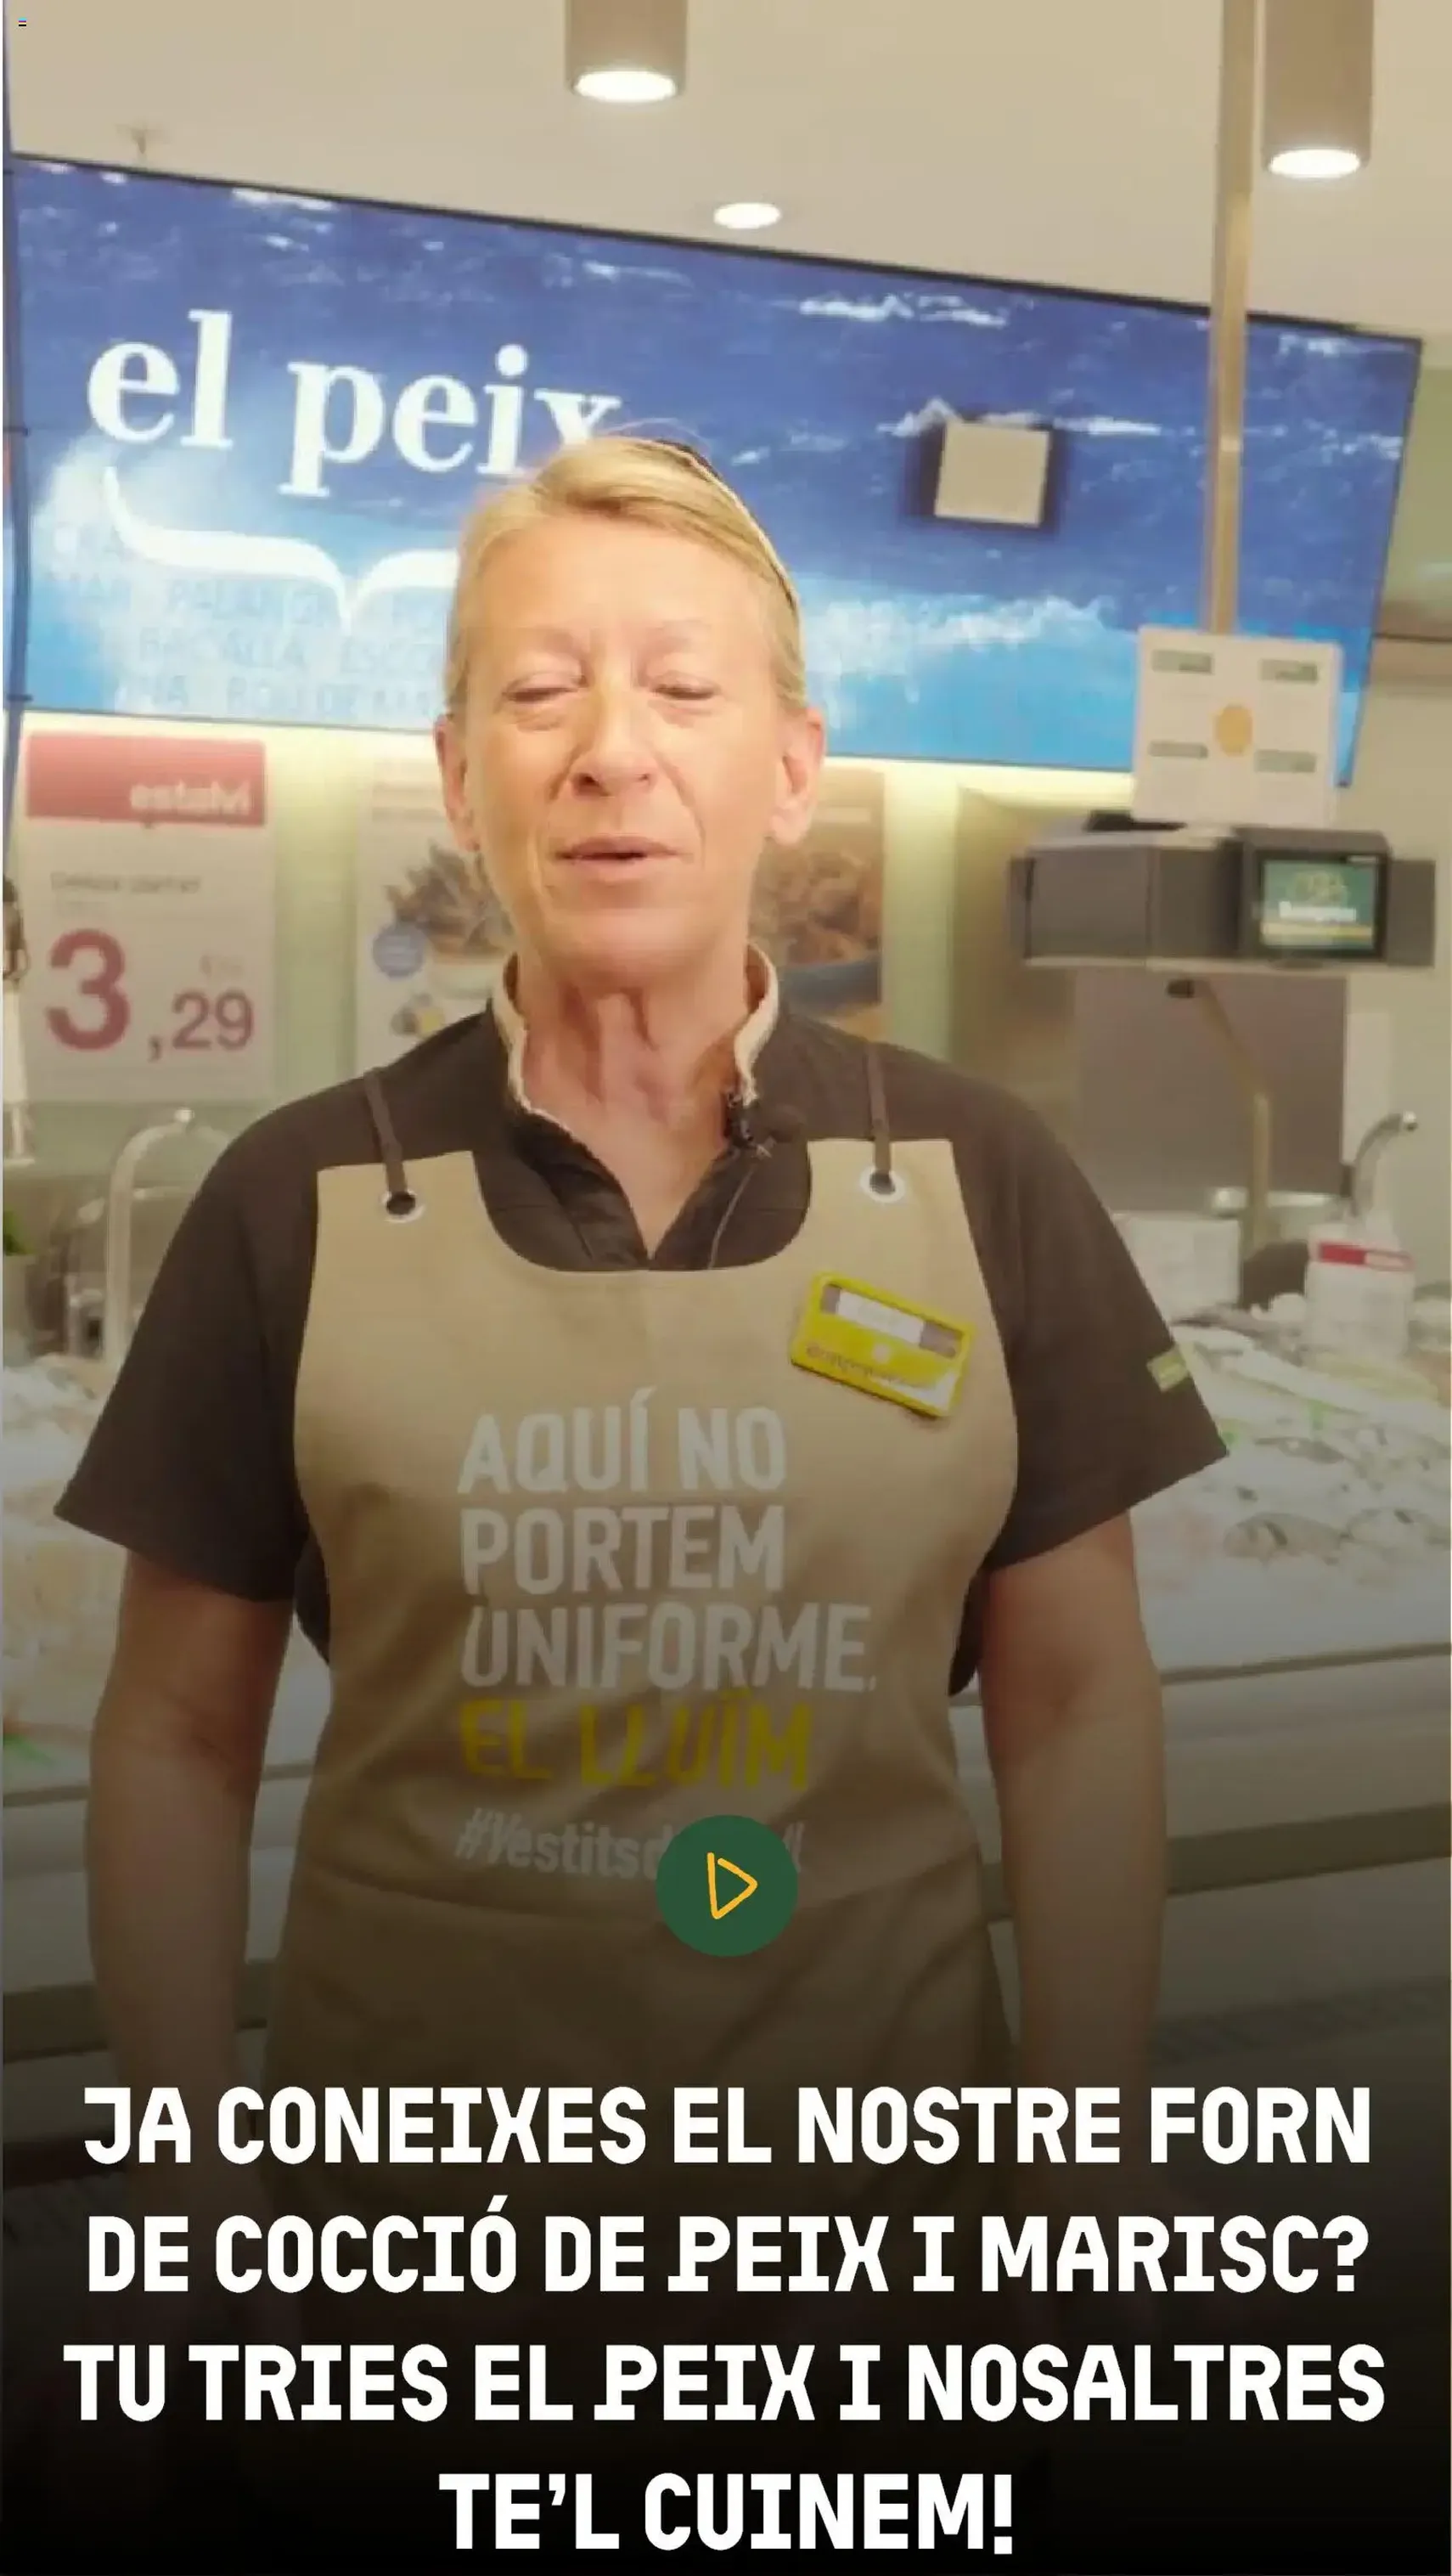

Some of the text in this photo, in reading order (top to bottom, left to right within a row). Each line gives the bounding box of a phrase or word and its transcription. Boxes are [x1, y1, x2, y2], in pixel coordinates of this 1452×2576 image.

[87, 309, 234, 449] el
[458, 1387, 787, 1495] AQUÍ NO
[461, 1505, 785, 1595] PORTEM
[459, 1699, 553, 1779] EL
